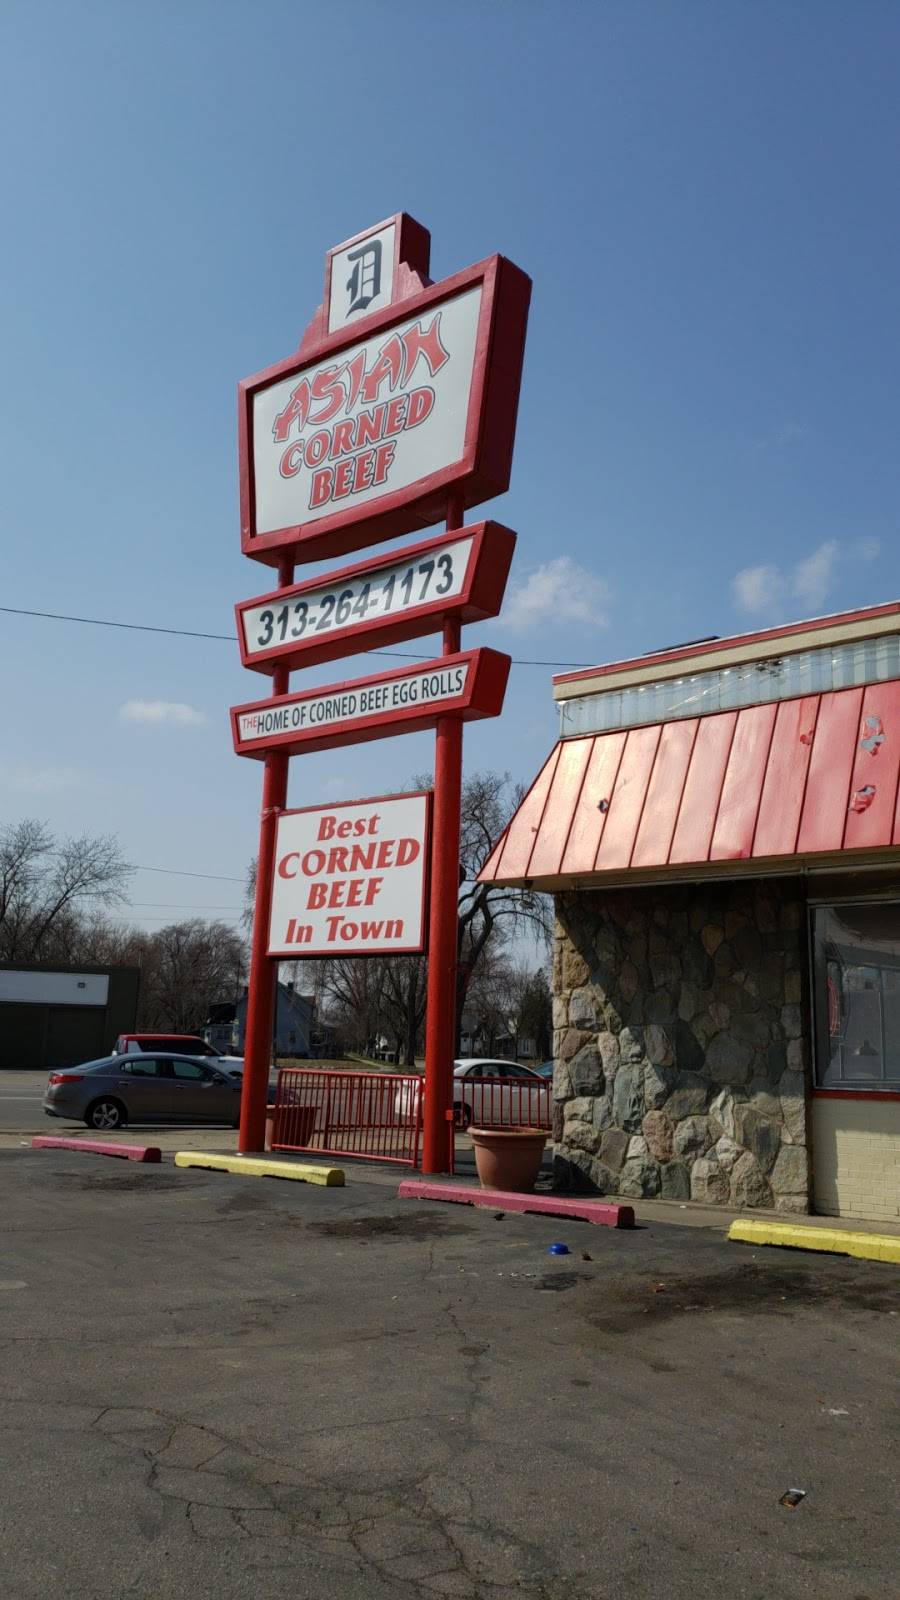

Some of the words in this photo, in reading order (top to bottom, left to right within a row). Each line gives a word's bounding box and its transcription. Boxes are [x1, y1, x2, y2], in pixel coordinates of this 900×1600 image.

[272, 311, 450, 443] ASIAN
[279, 385, 436, 479] CORNED
[308, 440, 397, 510] BEEF
[257, 553, 453, 646] 313-264-1173
[257, 708, 289, 734] HOME
[291, 706, 307, 728] OF
[309, 697, 357, 723] CORNED
[360, 687, 389, 713] BEEF
[392, 679, 417, 705] EGG
[421, 669, 463, 698] ROLLS
[278, 838, 420, 880] CORNED
[317, 813, 381, 842] Best
[306, 877, 384, 910] BEEF
[284, 918, 313, 944] In
[326, 915, 404, 942] Town
